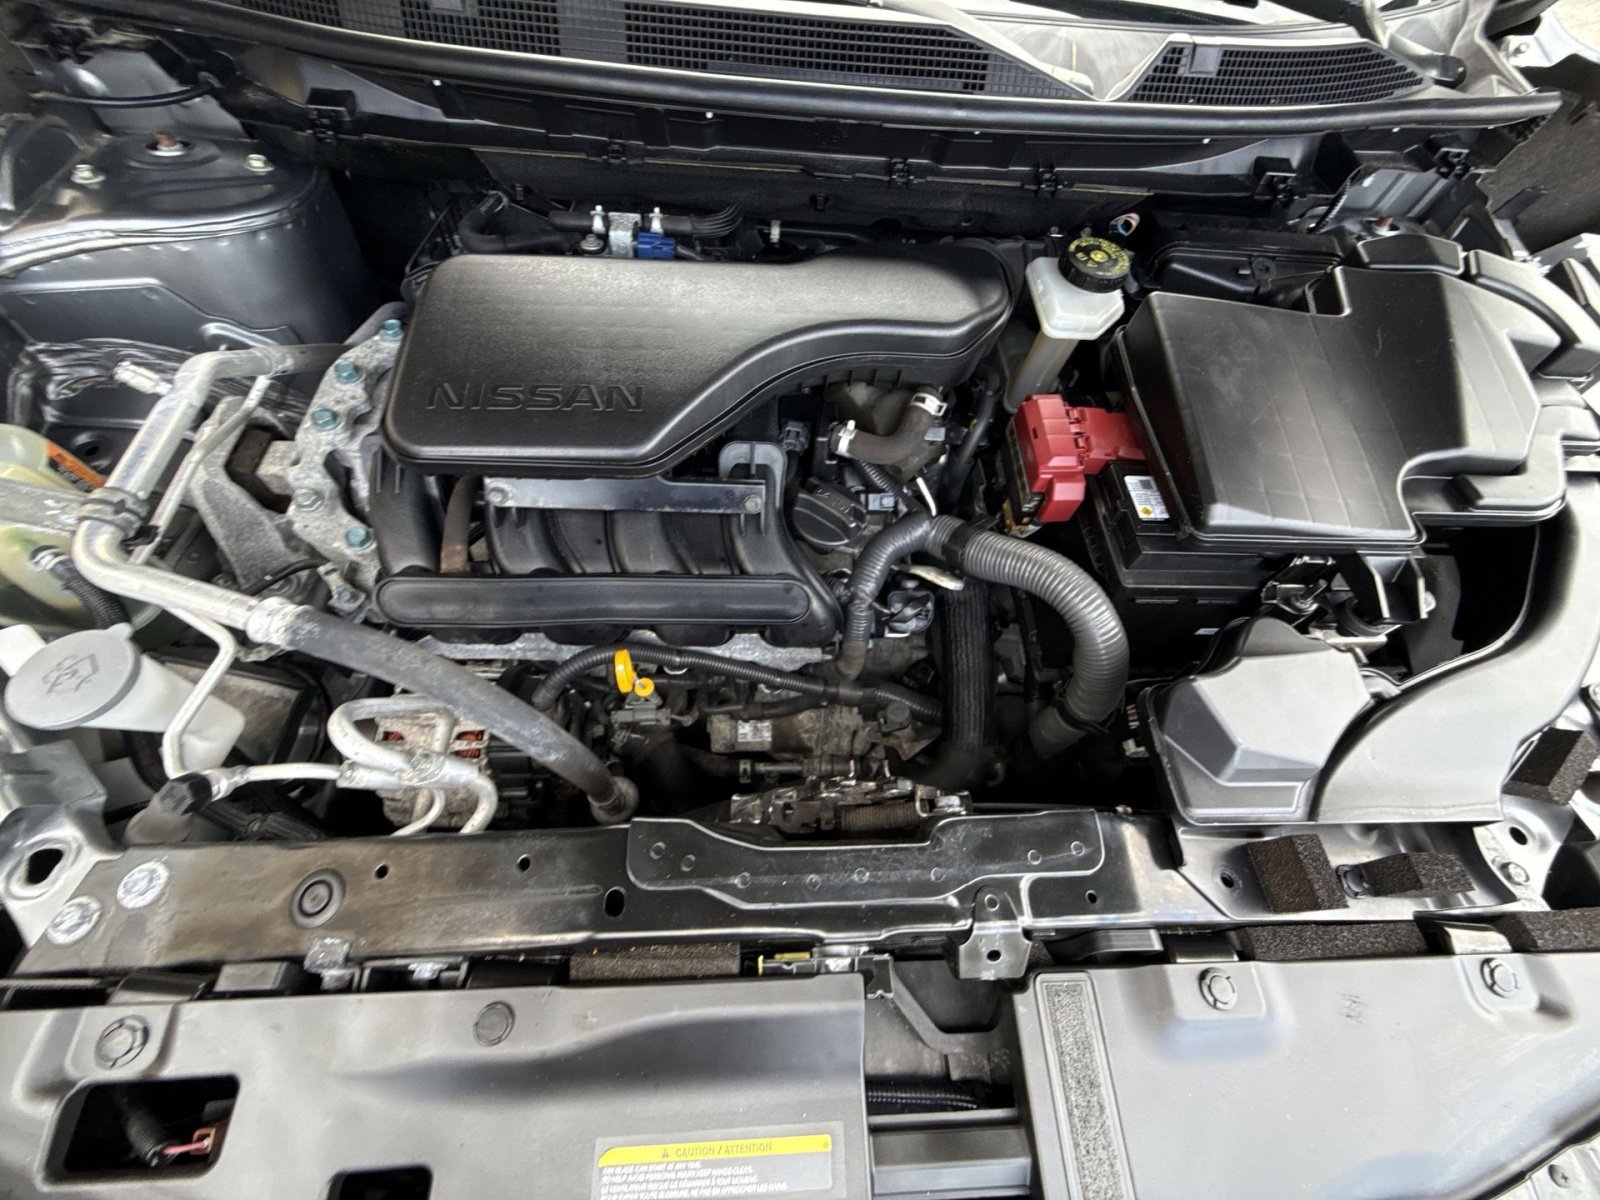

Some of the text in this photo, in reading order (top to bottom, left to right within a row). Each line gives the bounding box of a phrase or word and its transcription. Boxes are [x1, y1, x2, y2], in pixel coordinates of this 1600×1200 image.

[426, 383, 645, 412] NISSAN
[675, 1146, 715, 1158] CAUTION
[725, 1142, 772, 1154] ATTENTION
